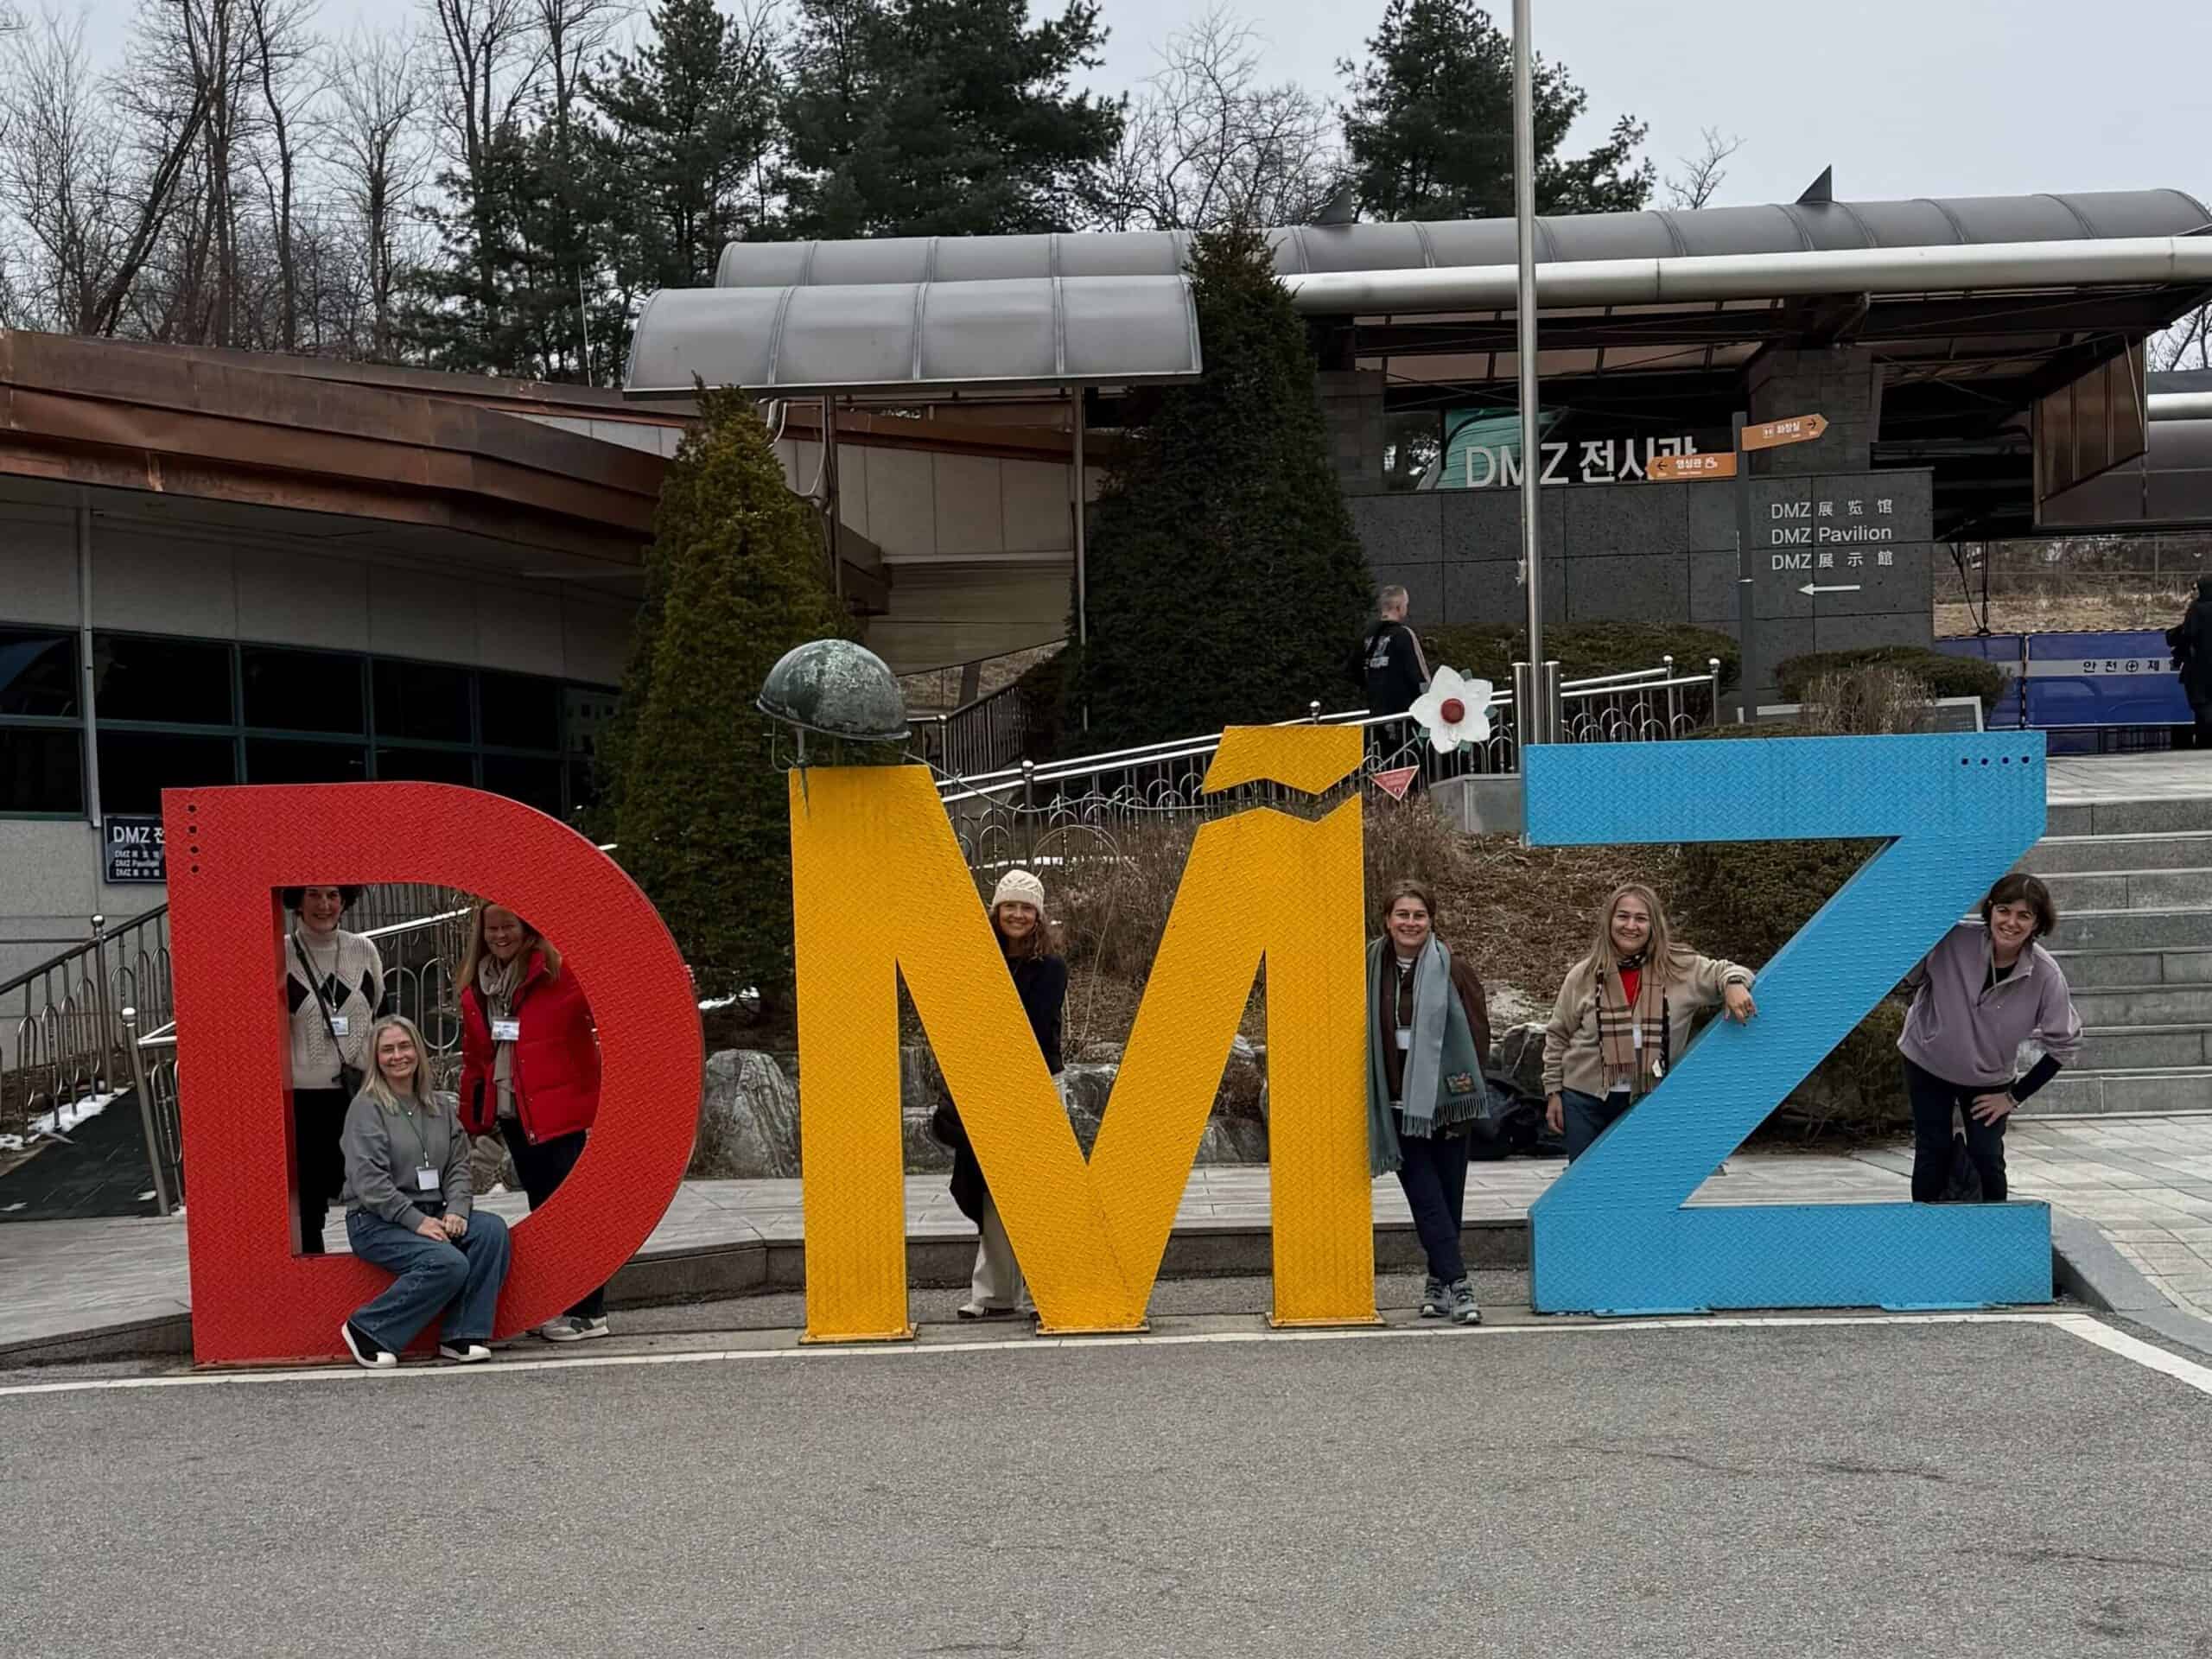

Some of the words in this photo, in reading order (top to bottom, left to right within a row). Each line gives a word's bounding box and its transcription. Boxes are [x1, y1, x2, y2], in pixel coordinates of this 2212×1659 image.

[1771, 502, 1812, 519] DMZ
[1771, 527, 1812, 544] DMZ
[1819, 524, 1892, 543] Pavilion
[1771, 553, 1812, 570] DMZ
[112, 825, 151, 844] DMZ
